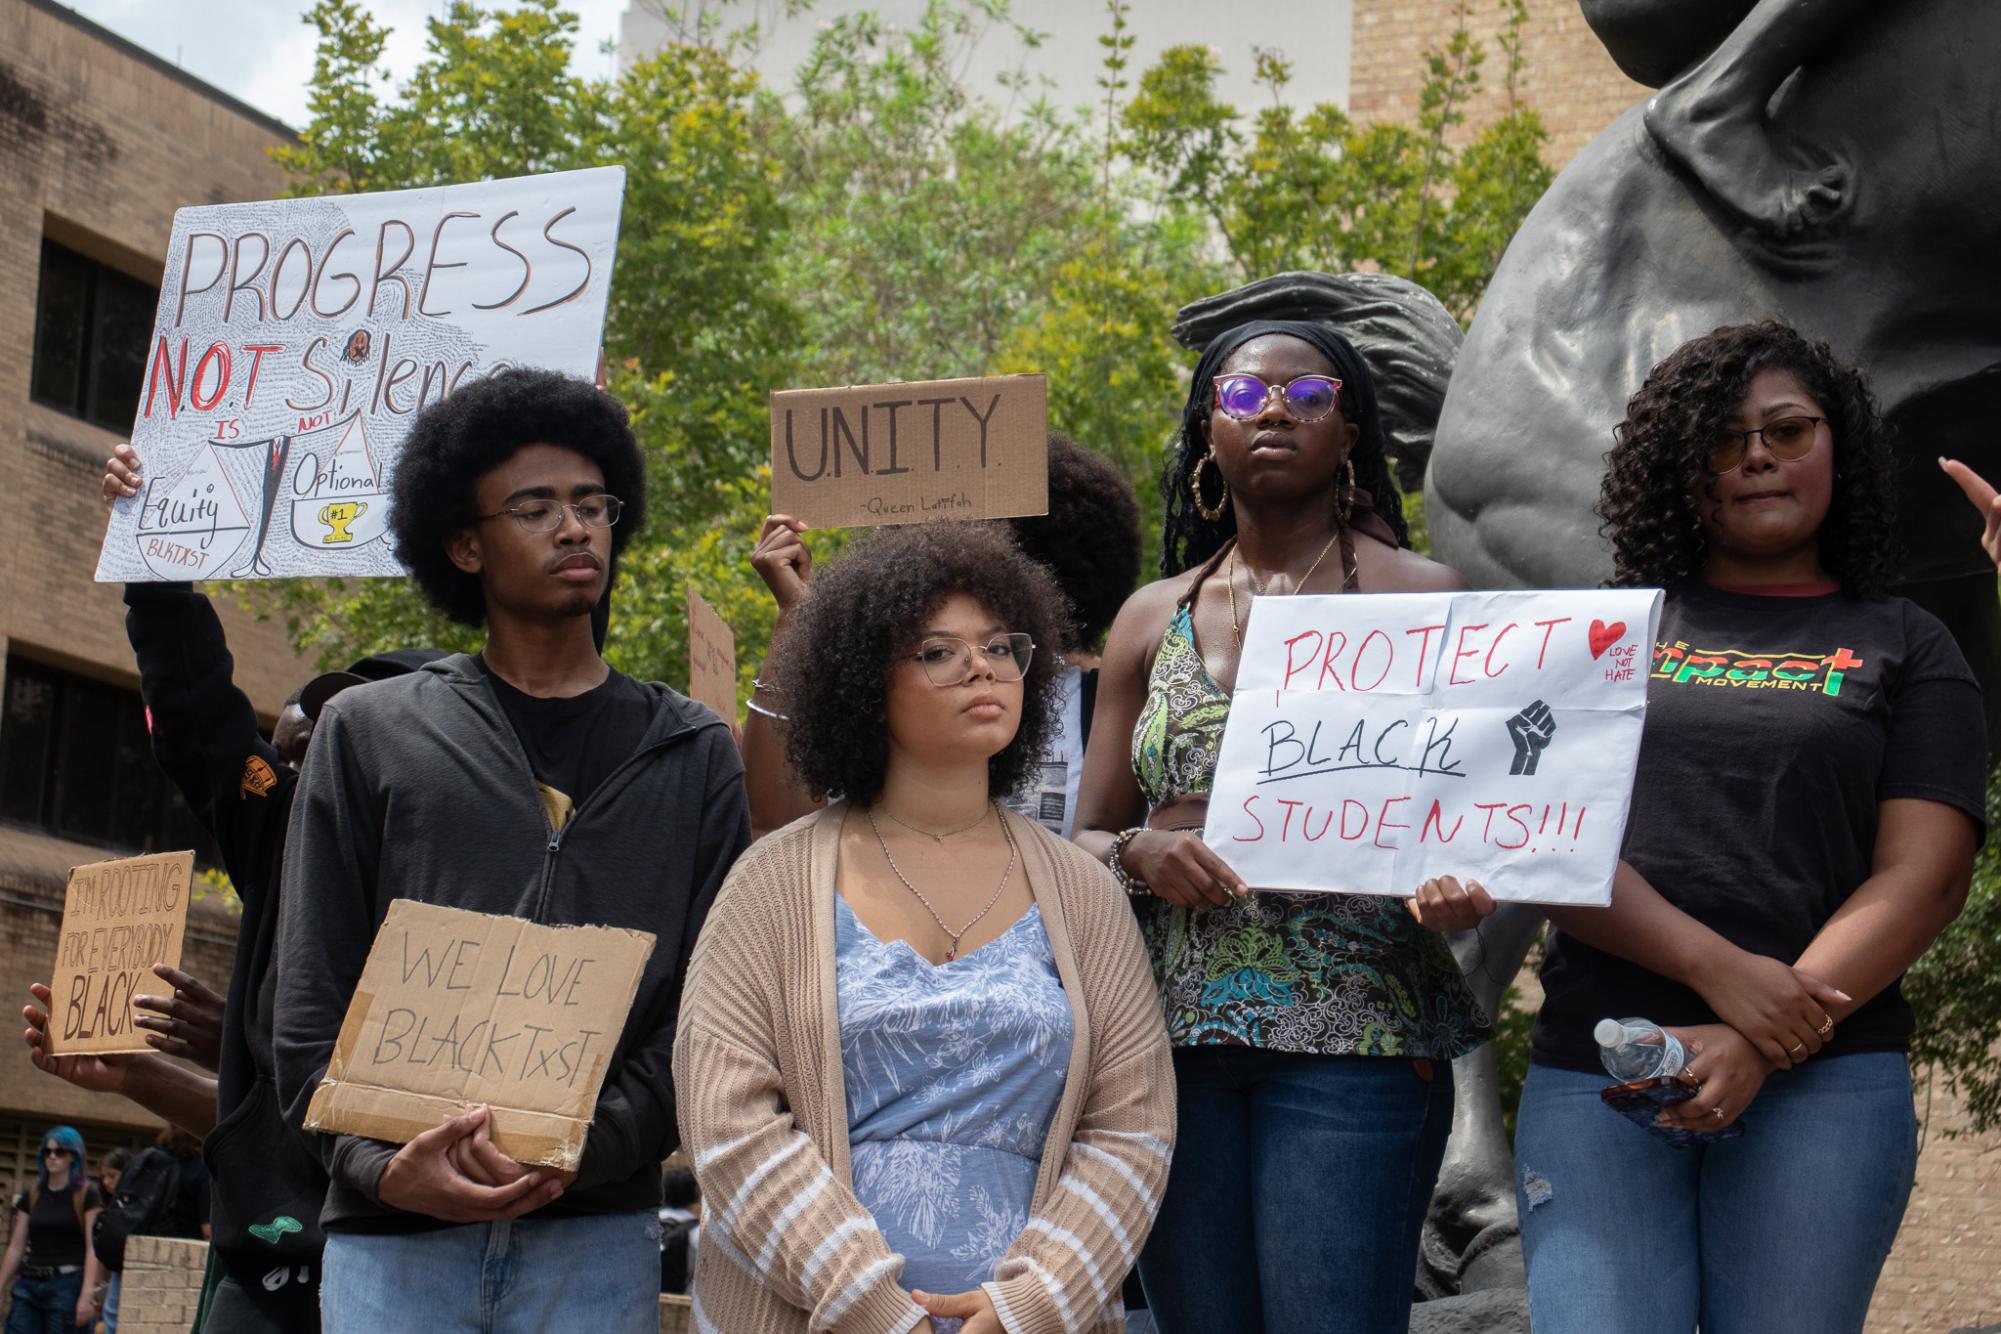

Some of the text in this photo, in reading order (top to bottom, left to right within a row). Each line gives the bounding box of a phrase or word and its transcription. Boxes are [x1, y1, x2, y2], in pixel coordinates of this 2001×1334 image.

[174, 206, 592, 328] PROGRESS
[286, 332, 513, 415] Silenc
[214, 411, 332, 440] IS NOT
[293, 452, 383, 497] Optional
[138, 476, 218, 549] Equity
[330, 508, 348, 520] #1
[146, 538, 210, 569] BLKTXST
[1283, 617, 1573, 691] PROTECT
[1609, 644, 1639, 657] LOVE
[1615, 658, 1634, 669] NOT
[1655, 641, 1690, 650] HE
[1605, 669, 1636, 682] HATE
[1696, 676, 1824, 693] MOVEMENT
[1259, 716, 1463, 778] BLACK
[1232, 796, 1586, 853] STUDENTS!!!
[96, 863, 183, 921] ROOTING
[61, 923, 174, 974] FOR EVERYBODY
[401, 931, 595, 1006] WE LOVE
[63, 971, 142, 1041] BLACK
